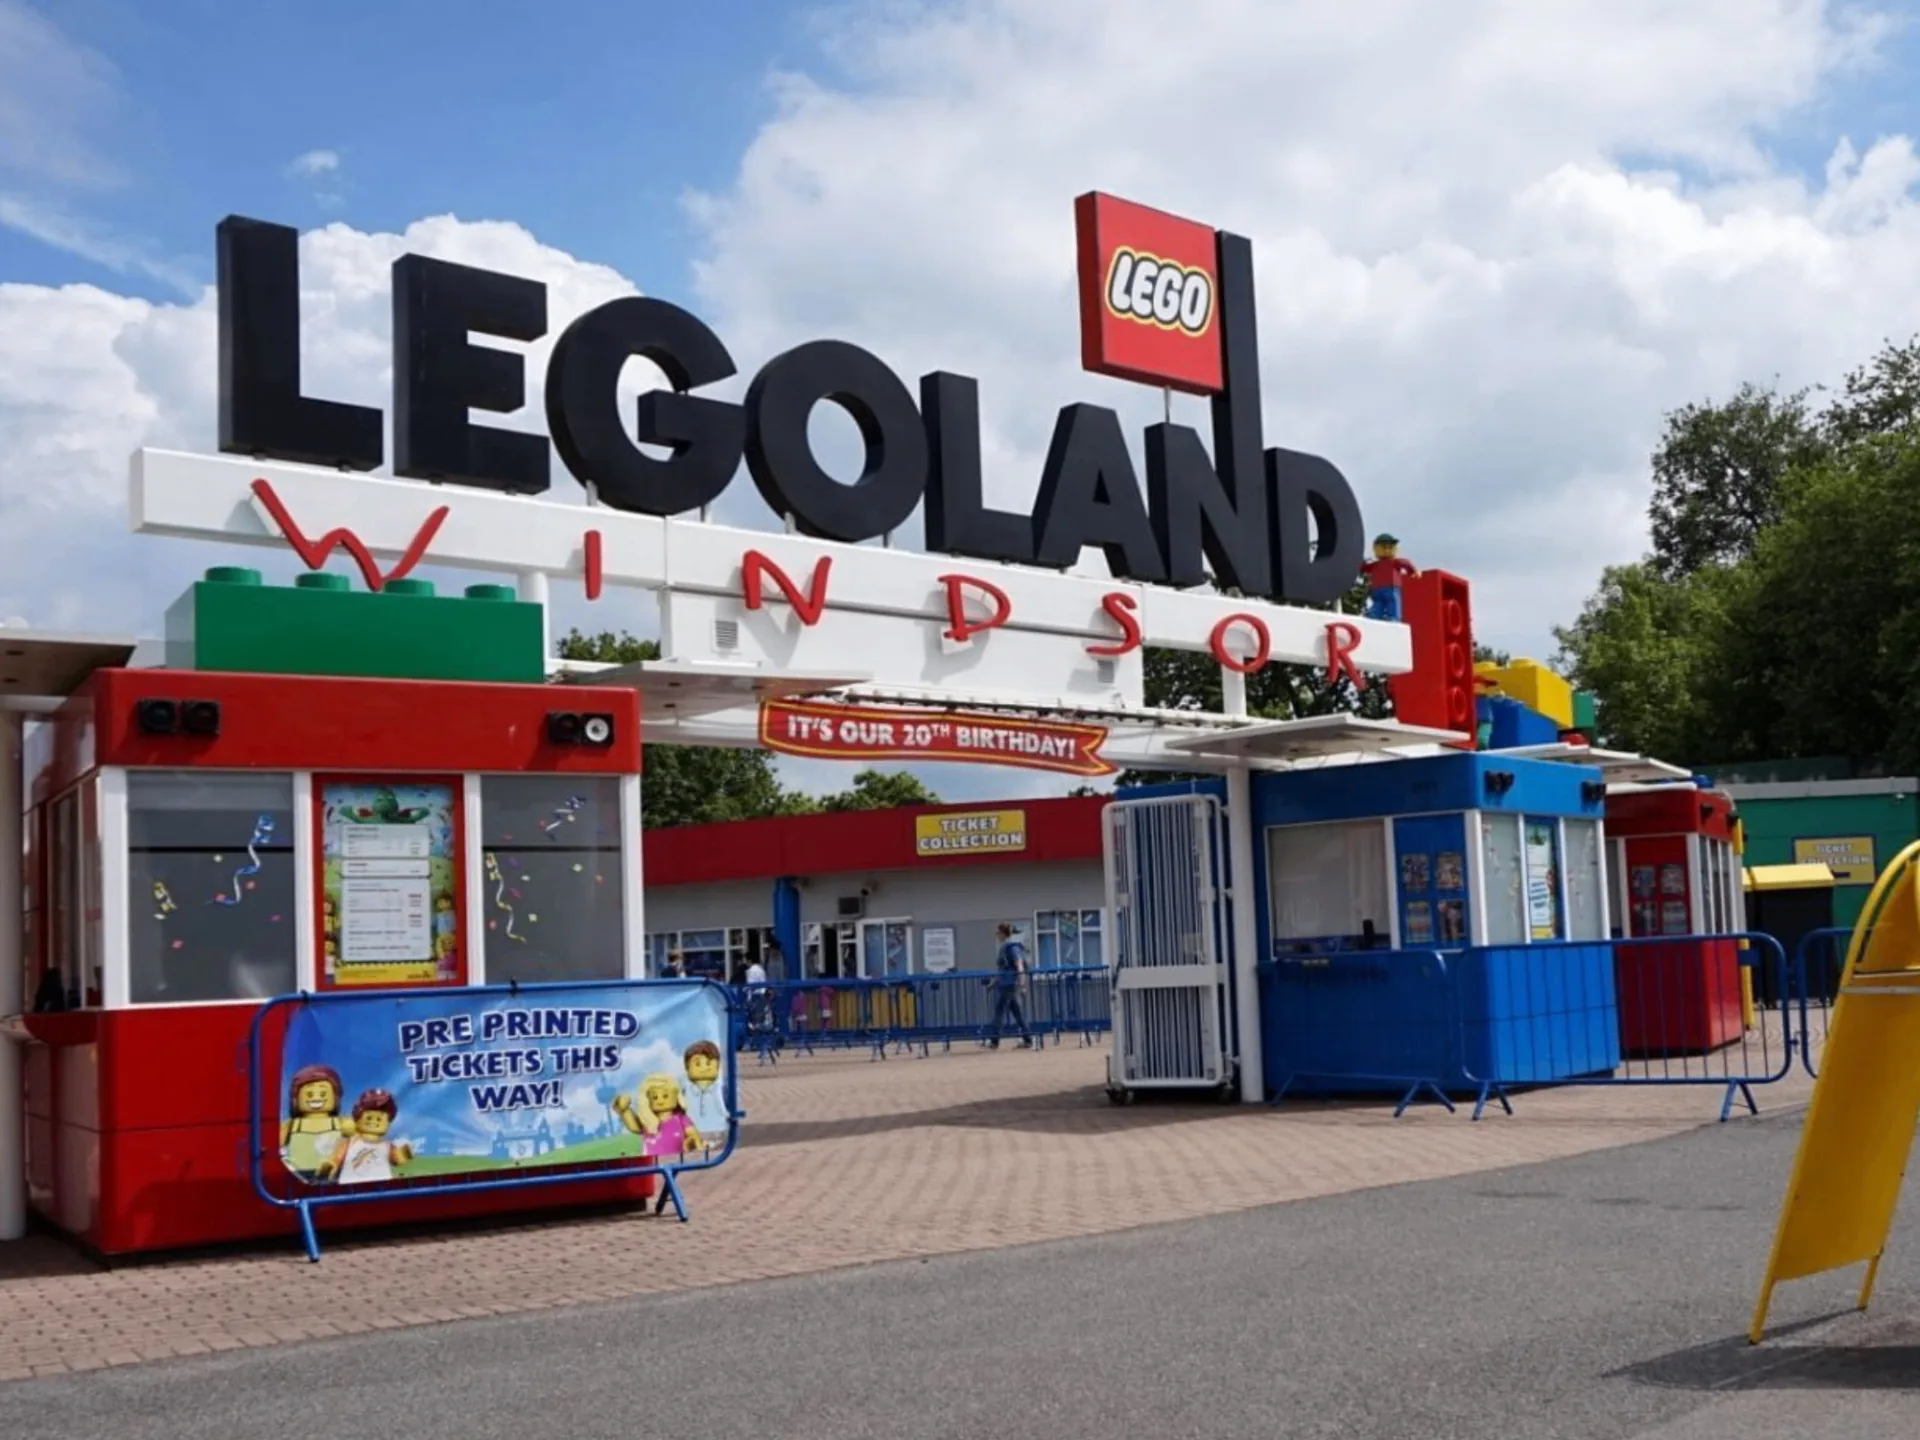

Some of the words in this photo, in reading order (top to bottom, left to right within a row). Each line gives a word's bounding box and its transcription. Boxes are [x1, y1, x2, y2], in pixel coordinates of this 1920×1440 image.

[1108, 249, 1212, 333] LEGO
[216, 213, 1364, 602] LEGOLAND
[251, 478, 1365, 688] WINDSOR
[787, 714, 833, 742] IT'S
[840, 720, 894, 746] OUR
[956, 728, 1076, 760] BIRTHDAY!
[919, 832, 1022, 850] COLLECTION
[940, 816, 998, 832] TICKET
[401, 1016, 472, 1050] PRE
[482, 1009, 638, 1040] PRINTED
[408, 1049, 542, 1081] TICKETS
[550, 1044, 621, 1071] THIS
[471, 1080, 560, 1110] WAY!
